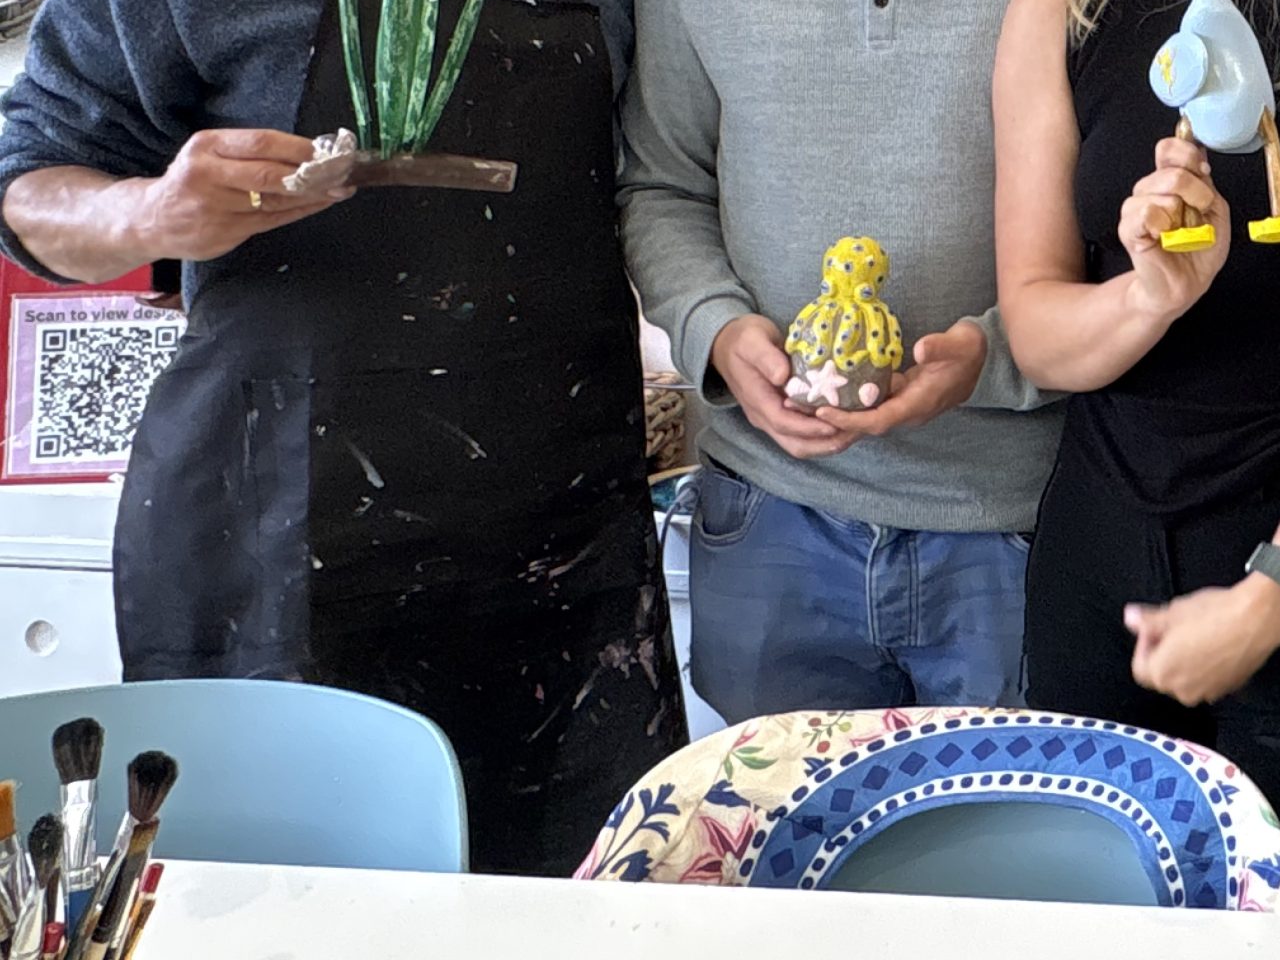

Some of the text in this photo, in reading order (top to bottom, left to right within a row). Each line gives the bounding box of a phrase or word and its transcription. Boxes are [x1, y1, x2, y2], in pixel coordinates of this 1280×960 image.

[25, 309, 66, 323] Scan
[71, 310, 88, 321] to
[92, 307, 129, 321] view
